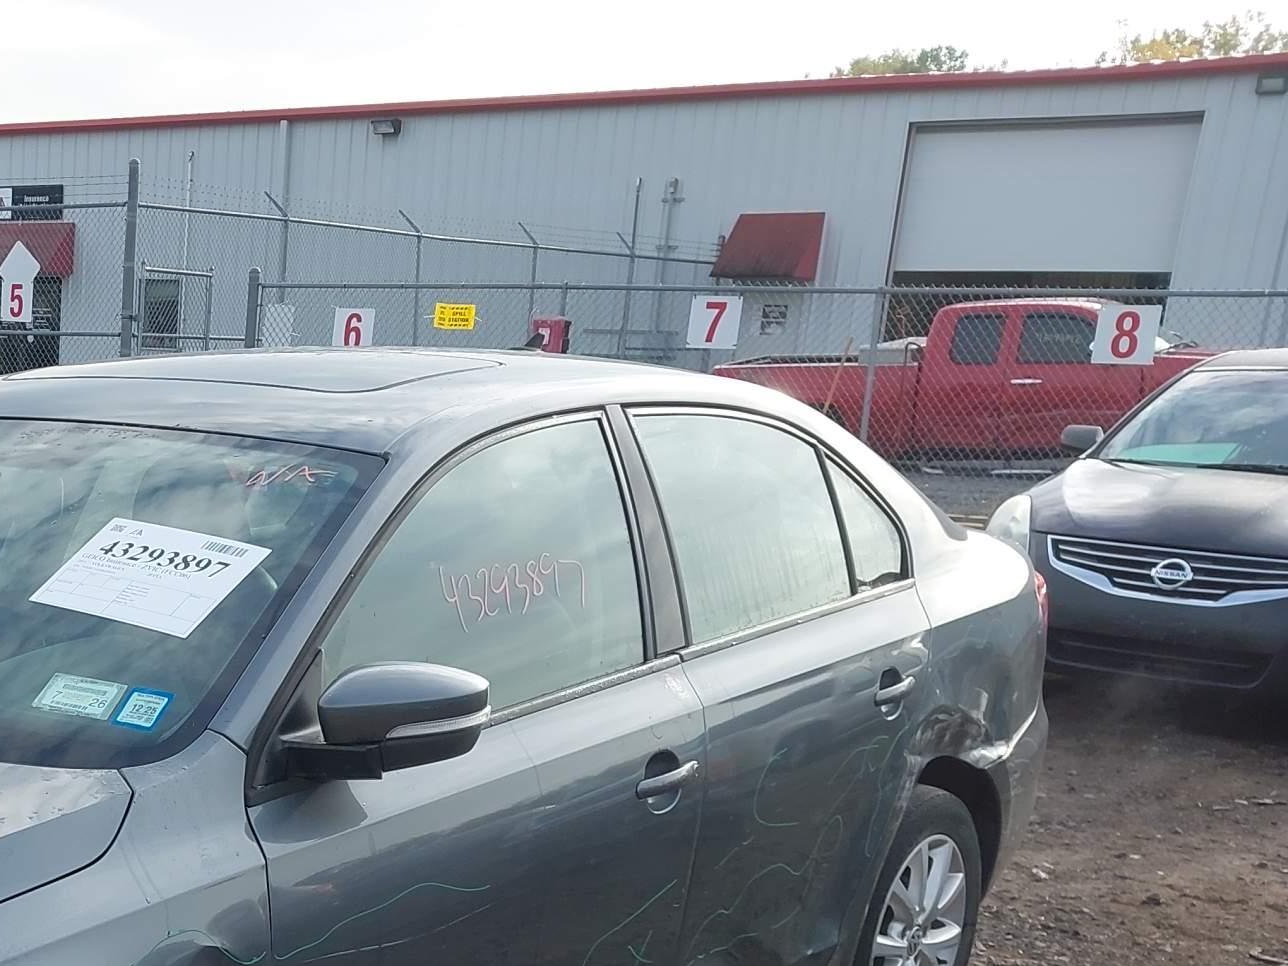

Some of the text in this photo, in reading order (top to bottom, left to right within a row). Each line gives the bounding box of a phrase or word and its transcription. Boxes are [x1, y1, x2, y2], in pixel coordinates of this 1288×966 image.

[9, 283, 24, 318] 5
[343, 312, 362, 346] 6
[705, 302, 728, 343] 7
[1110, 310, 1140, 359] 8
[99, 540, 232, 578] 43293897
[1155, 569, 1188, 578] NISSAN
[438, 552, 585, 633] 43293897
[52, 690, 63, 699] 7
[88, 698, 107, 709] 26
